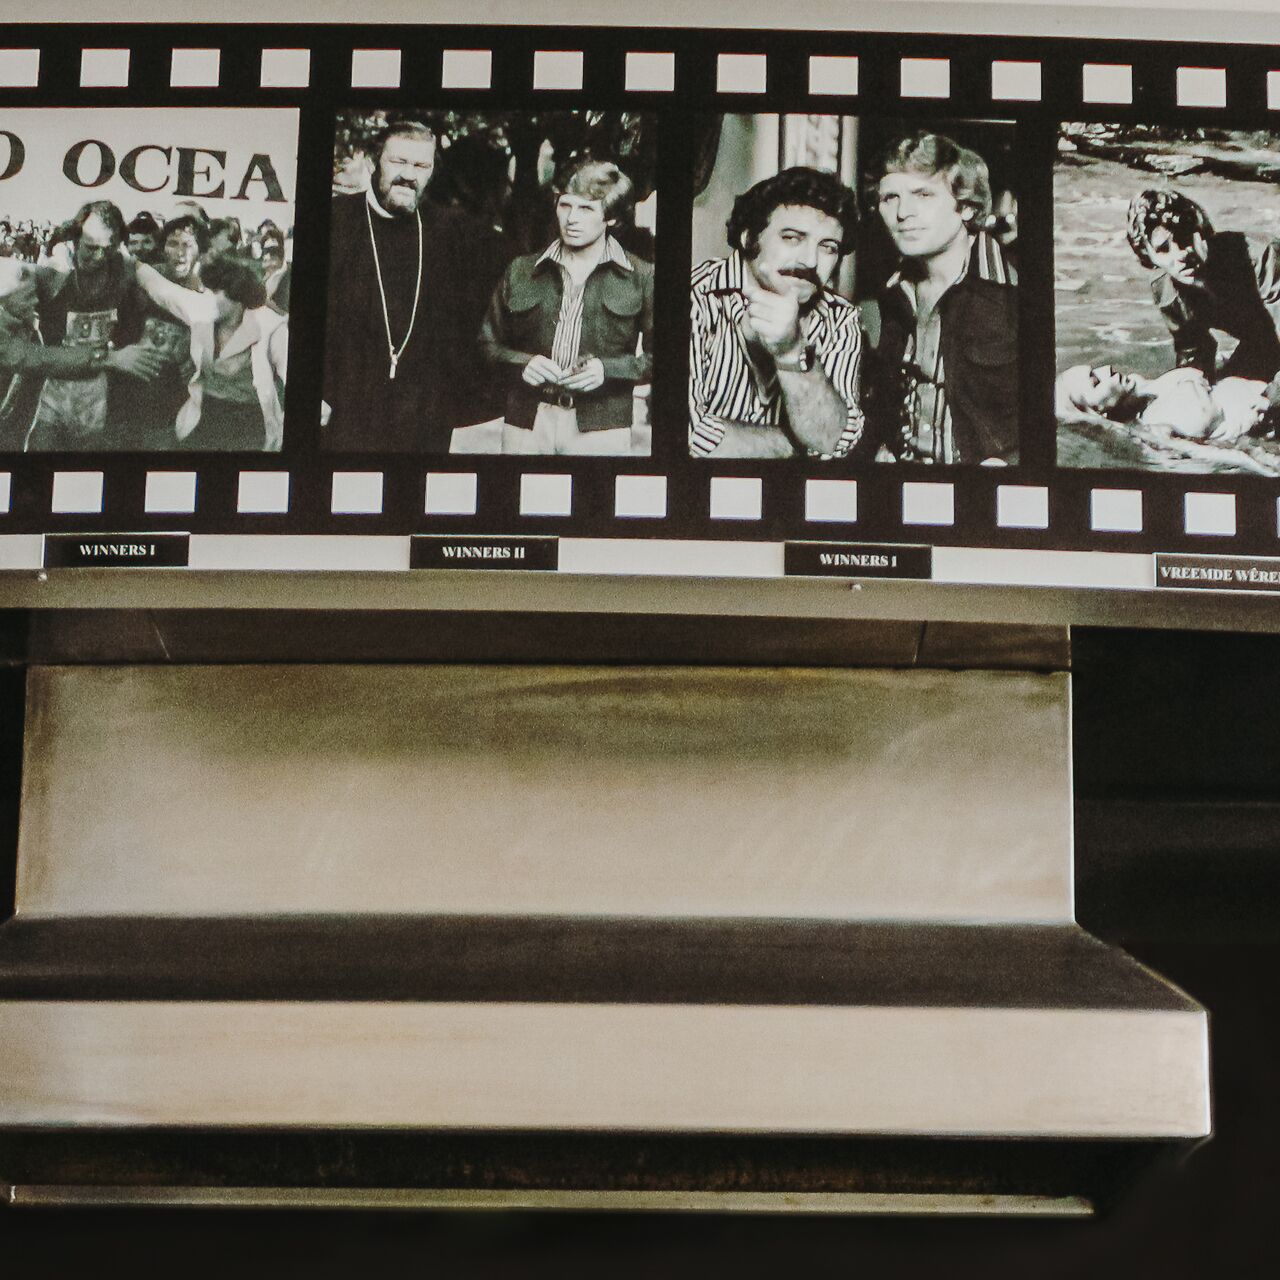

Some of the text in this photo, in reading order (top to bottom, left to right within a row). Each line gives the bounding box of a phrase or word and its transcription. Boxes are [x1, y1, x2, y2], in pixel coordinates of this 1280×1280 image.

[63, 139, 289, 203] OCEA
[79, 544, 156, 556] WINNERS I
[442, 546, 525, 559] WINNERS II
[819, 553, 889, 567] WINNERS
[1161, 566, 1233, 580] VREEMDE
